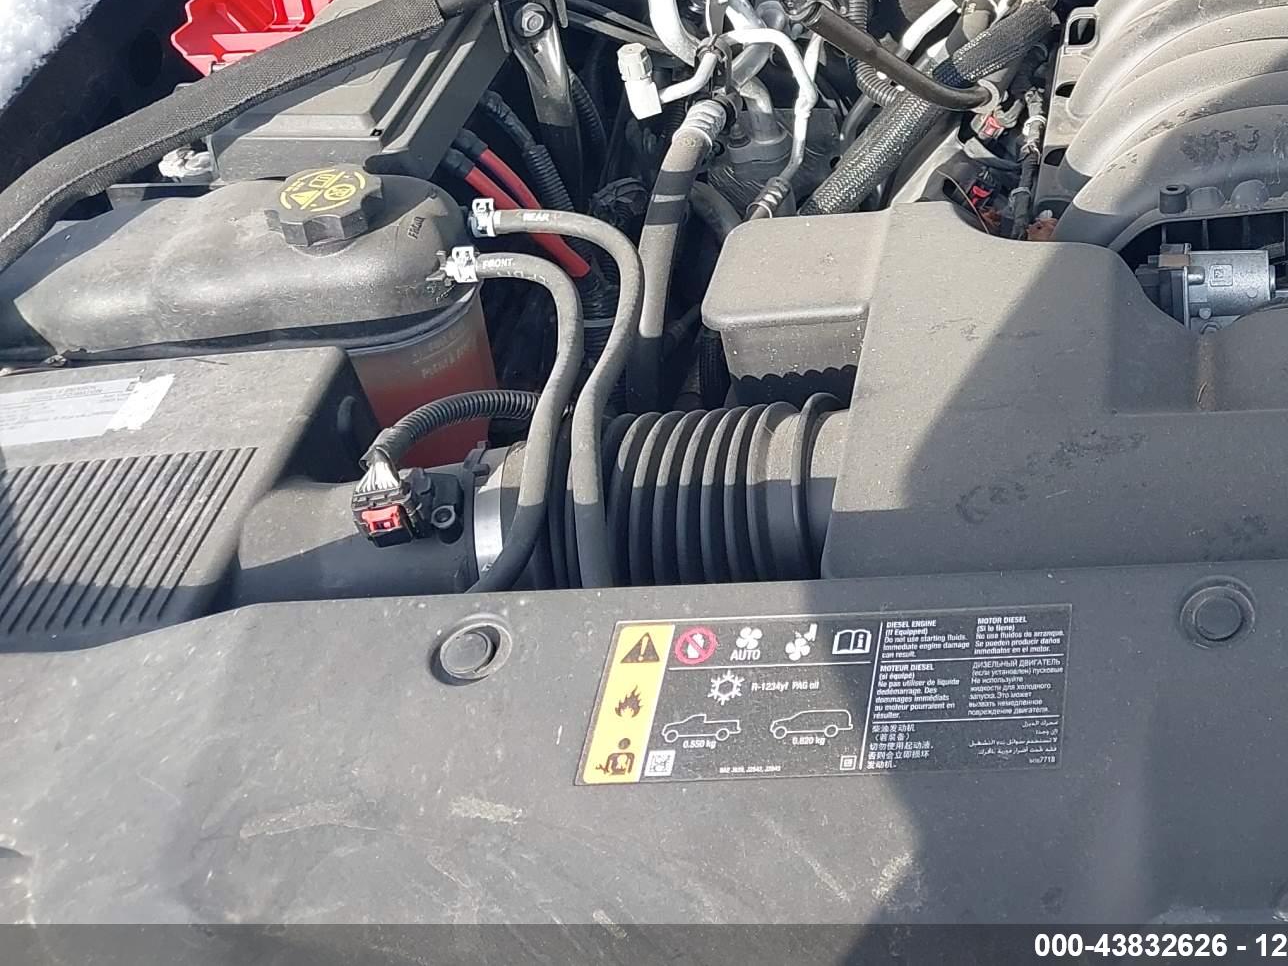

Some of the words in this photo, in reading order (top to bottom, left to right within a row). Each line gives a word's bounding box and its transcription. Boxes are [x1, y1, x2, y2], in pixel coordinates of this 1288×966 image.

[523, 212, 550, 222] REAR
[730, 649, 761, 661] AUTO
[972, 659, 1017, 668] ДИЗЕЛЬНЫЙ
[751, 681, 789, 692] R-1234yf
[792, 681, 808, 690] PAG
[910, 703, 945, 711] pourraient
[705, 739, 717, 749] kg
[815, 735, 826, 746] kg
